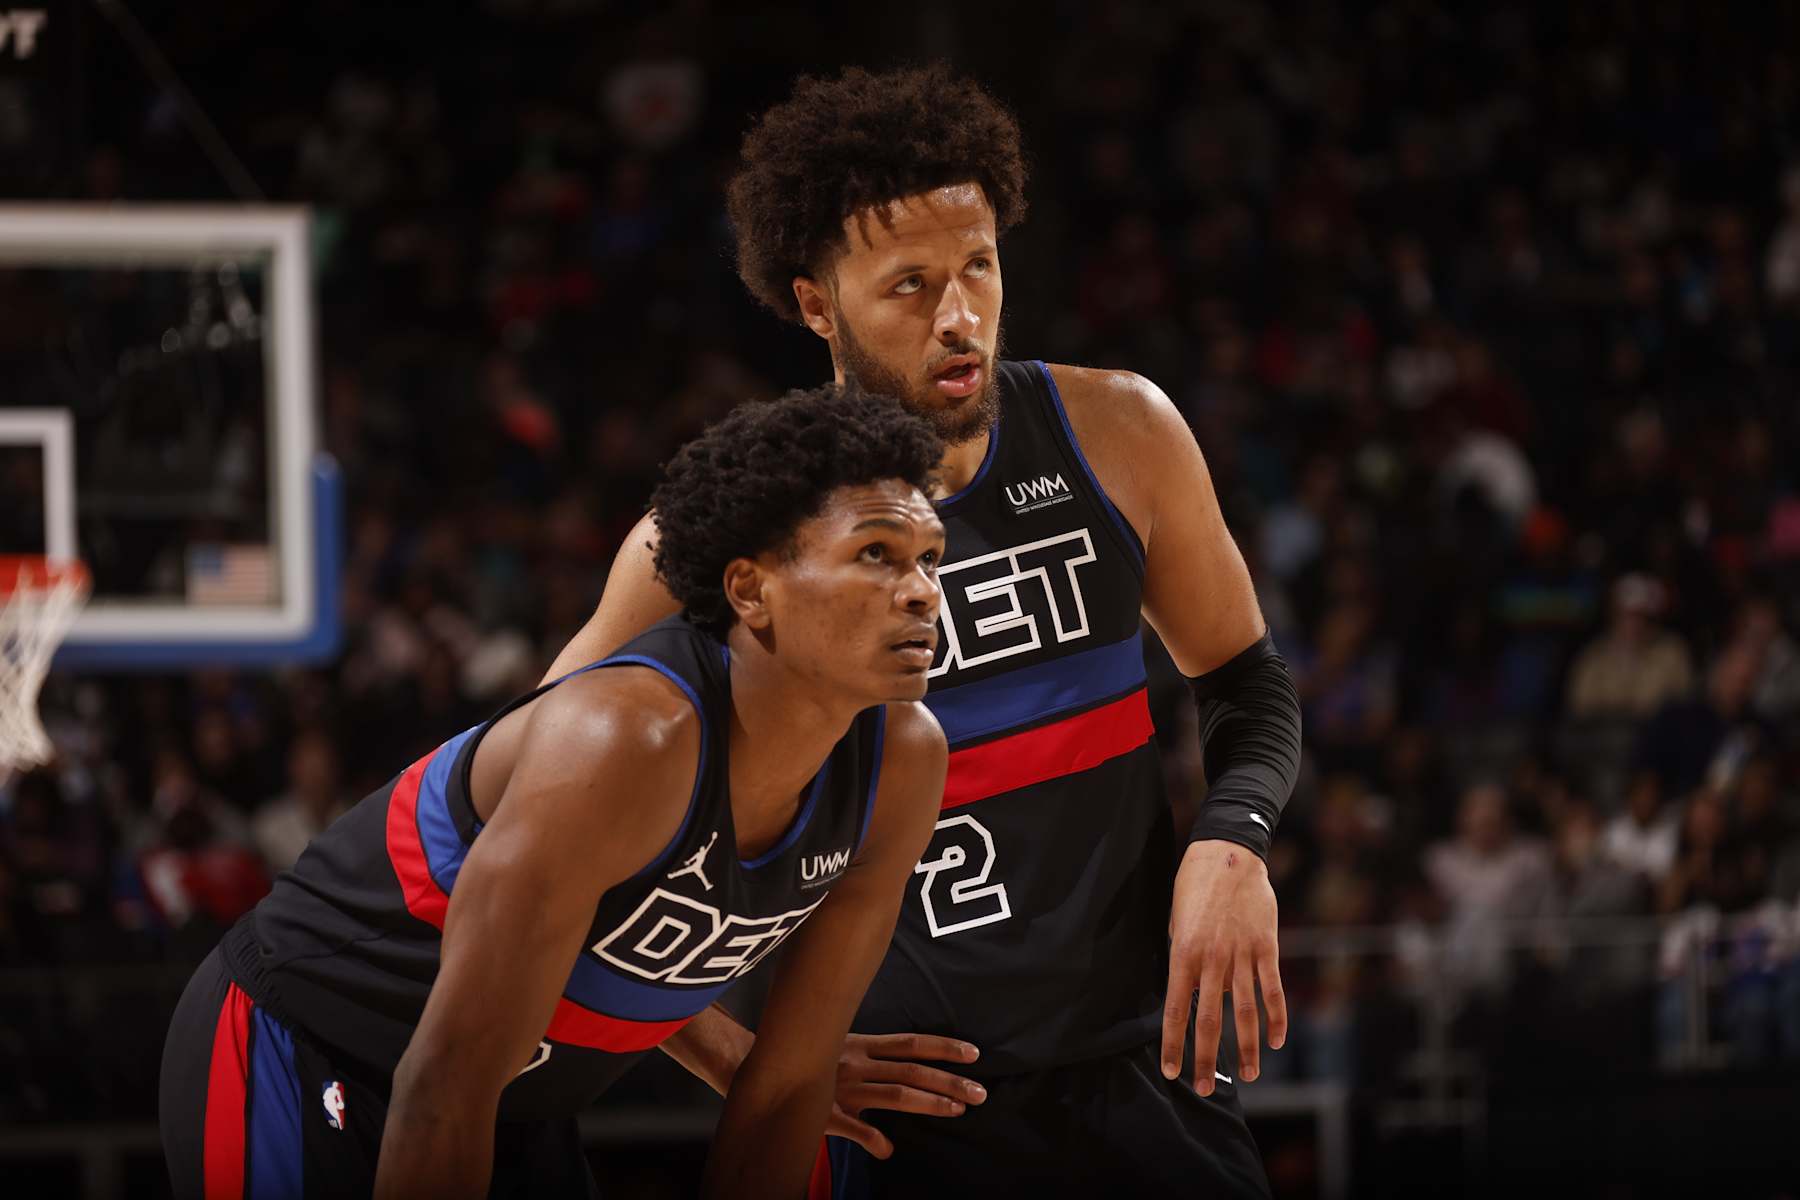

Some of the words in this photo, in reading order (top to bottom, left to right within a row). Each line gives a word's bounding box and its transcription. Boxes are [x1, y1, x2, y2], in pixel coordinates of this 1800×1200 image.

[1005, 472, 1070, 506] UWM
[927, 527, 1097, 679] ET
[801, 847, 851, 881] UWM
[914, 814, 1012, 938] 2
